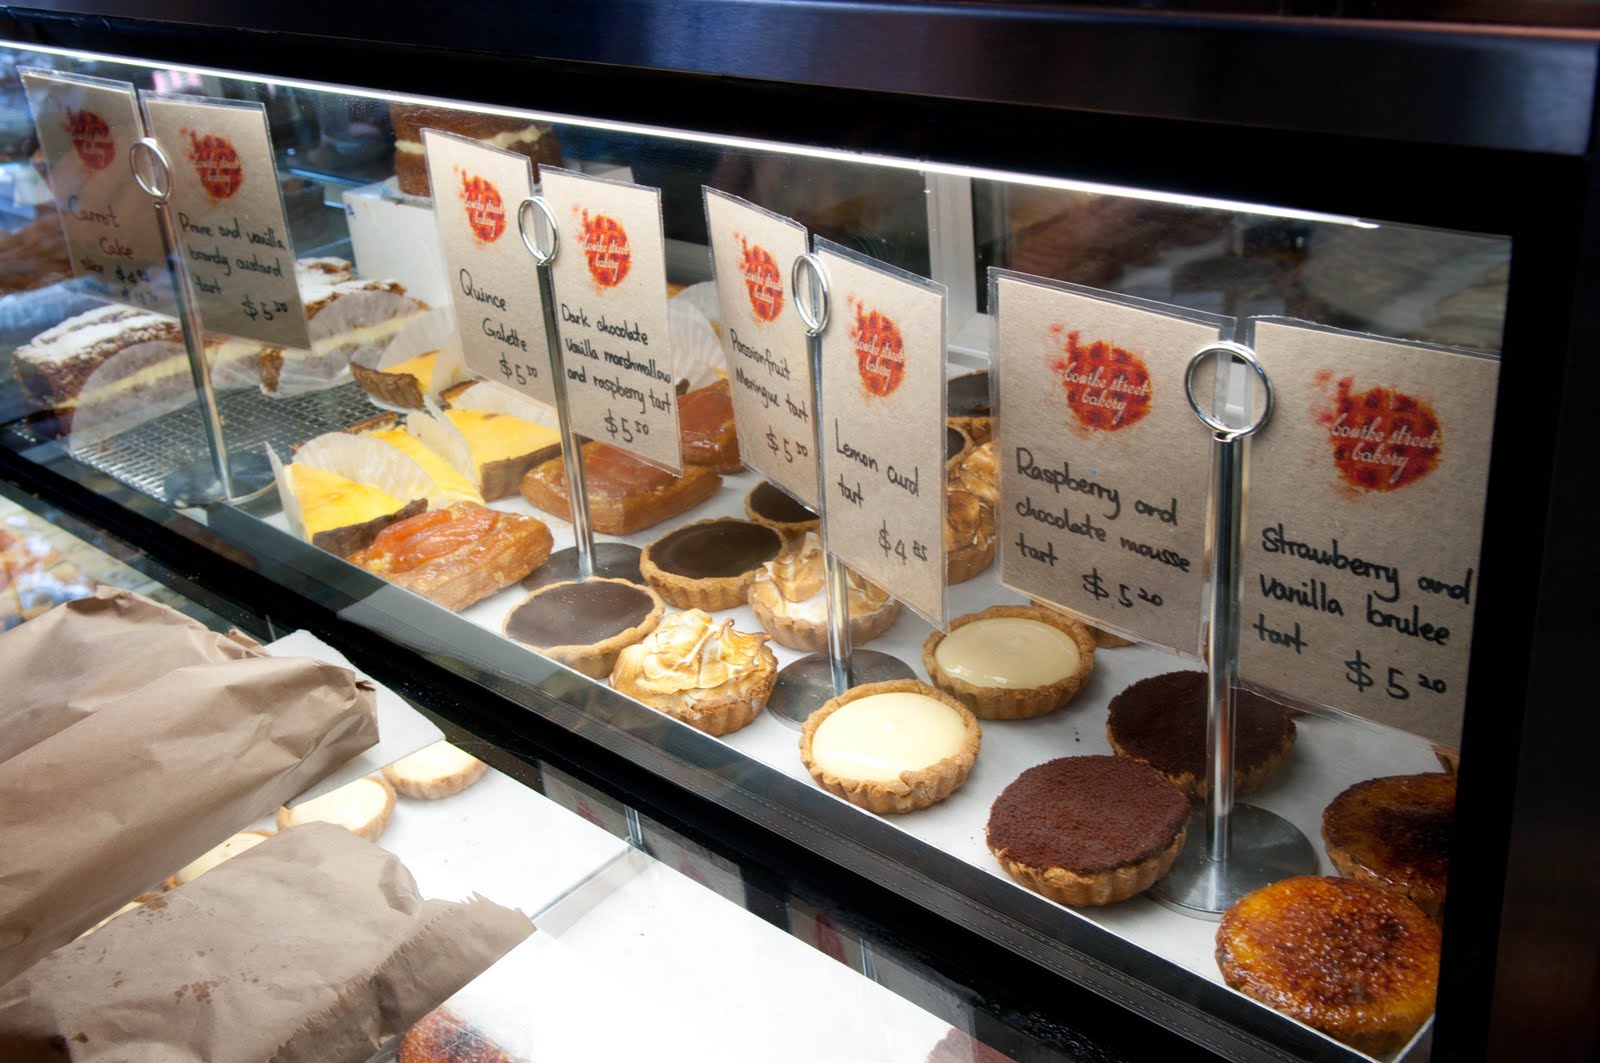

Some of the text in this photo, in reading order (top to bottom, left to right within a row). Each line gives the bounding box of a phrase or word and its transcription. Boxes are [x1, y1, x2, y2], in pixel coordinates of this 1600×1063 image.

[219, 217, 242, 240] and
[195, 274, 222, 295] tart
[236, 253, 283, 278] custard
[460, 269, 507, 312] Quince
[483, 317, 527, 352] Galette
[561, 303, 648, 345] Dark chocolate
[604, 350, 671, 384] marshmallow
[1108, 374, 1151, 397] street
[568, 366, 671, 414] and raspberry tart
[735, 367, 809, 424] Meringue tart
[1082, 385, 1127, 425] bakery
[835, 417, 879, 473] Lemon
[1330, 413, 1438, 450] bourke street
[1352, 443, 1408, 484] bakery
[837, 473, 864, 509] tart
[1016, 447, 1179, 527] Raspberry and
[1015, 532, 1058, 568] tart
[1016, 497, 1193, 574] chocolate mousse
[1417, 568, 1473, 605] and
[1253, 613, 1308, 655] tart
[1366, 594, 1451, 646] brulee
